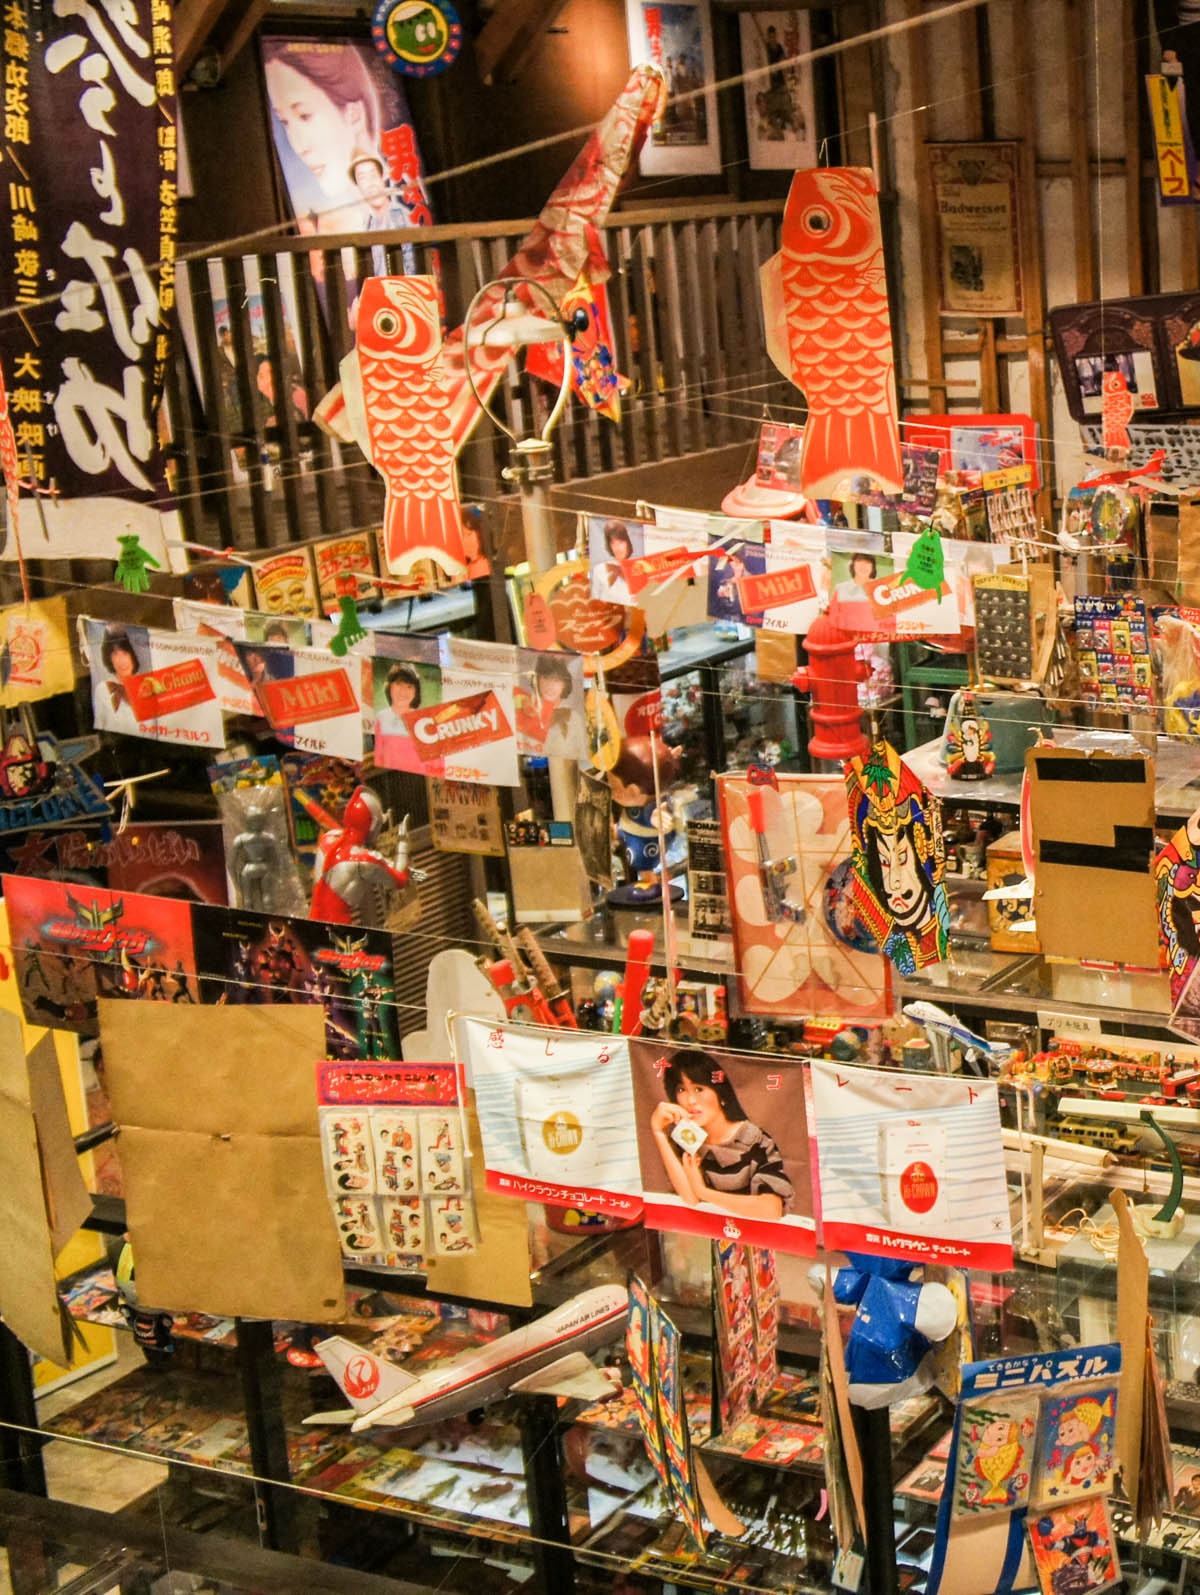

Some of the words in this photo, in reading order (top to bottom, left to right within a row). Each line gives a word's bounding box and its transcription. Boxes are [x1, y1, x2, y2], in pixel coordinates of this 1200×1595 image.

[280, 678, 340, 712] Mild
[414, 708, 498, 744] CRUNKY
[556, 1317, 580, 1334] JAPAN
[579, 1314, 591, 1324] AIR
[590, 1305, 610, 1320] LINES
[974, 1354, 1108, 1389] ミニパズル
